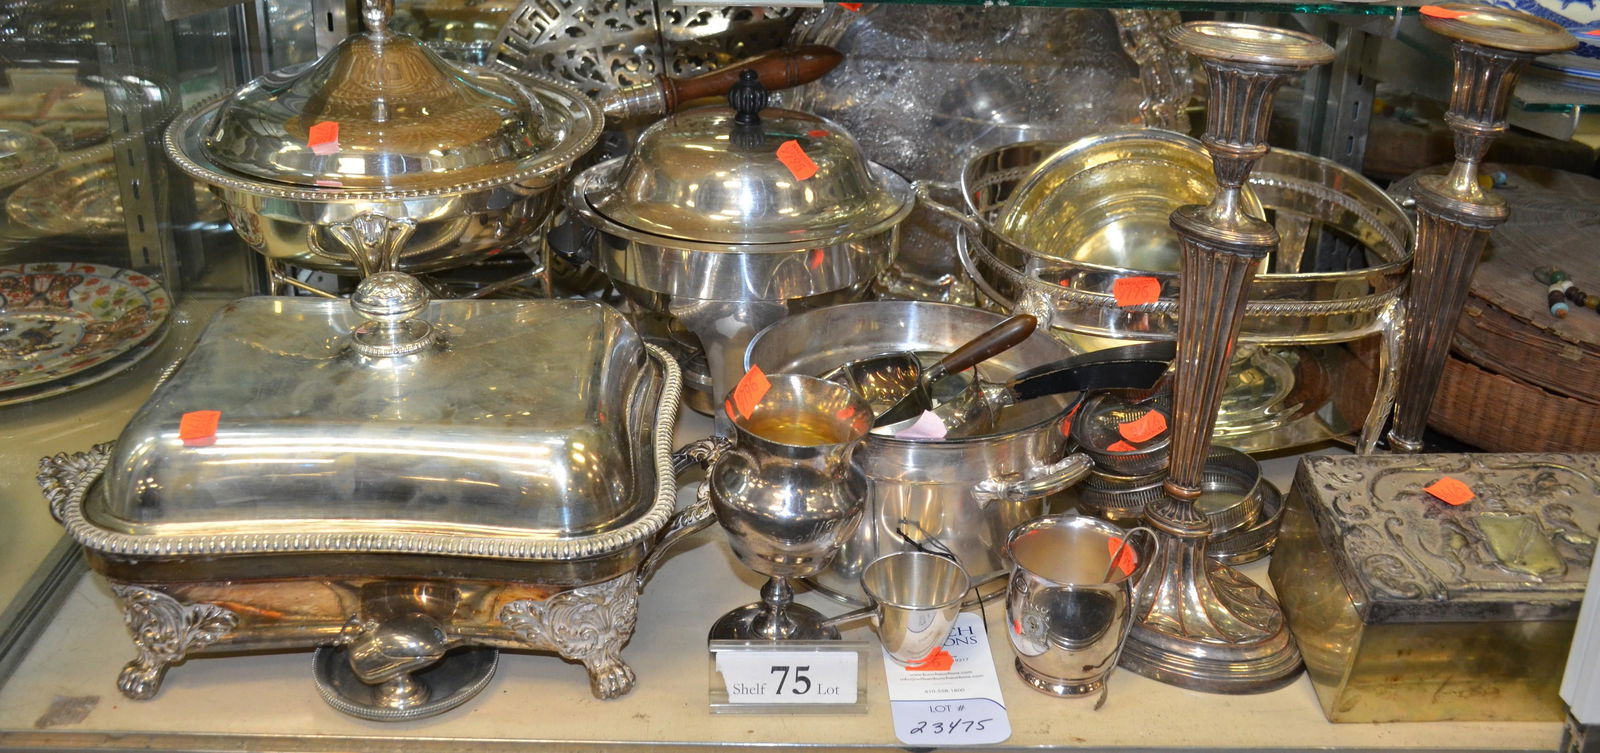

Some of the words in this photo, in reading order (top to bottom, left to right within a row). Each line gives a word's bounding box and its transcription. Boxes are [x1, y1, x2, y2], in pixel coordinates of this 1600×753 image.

[948, 626, 973, 636] CH
[943, 636, 978, 647] ONS
[732, 683, 767, 695] Shelf
[770, 665, 812, 695] 75
[818, 683, 840, 695] Lot
[929, 704, 952, 713] LOT
[957, 704, 969, 712] #
[909, 718, 994, 735] 23475
